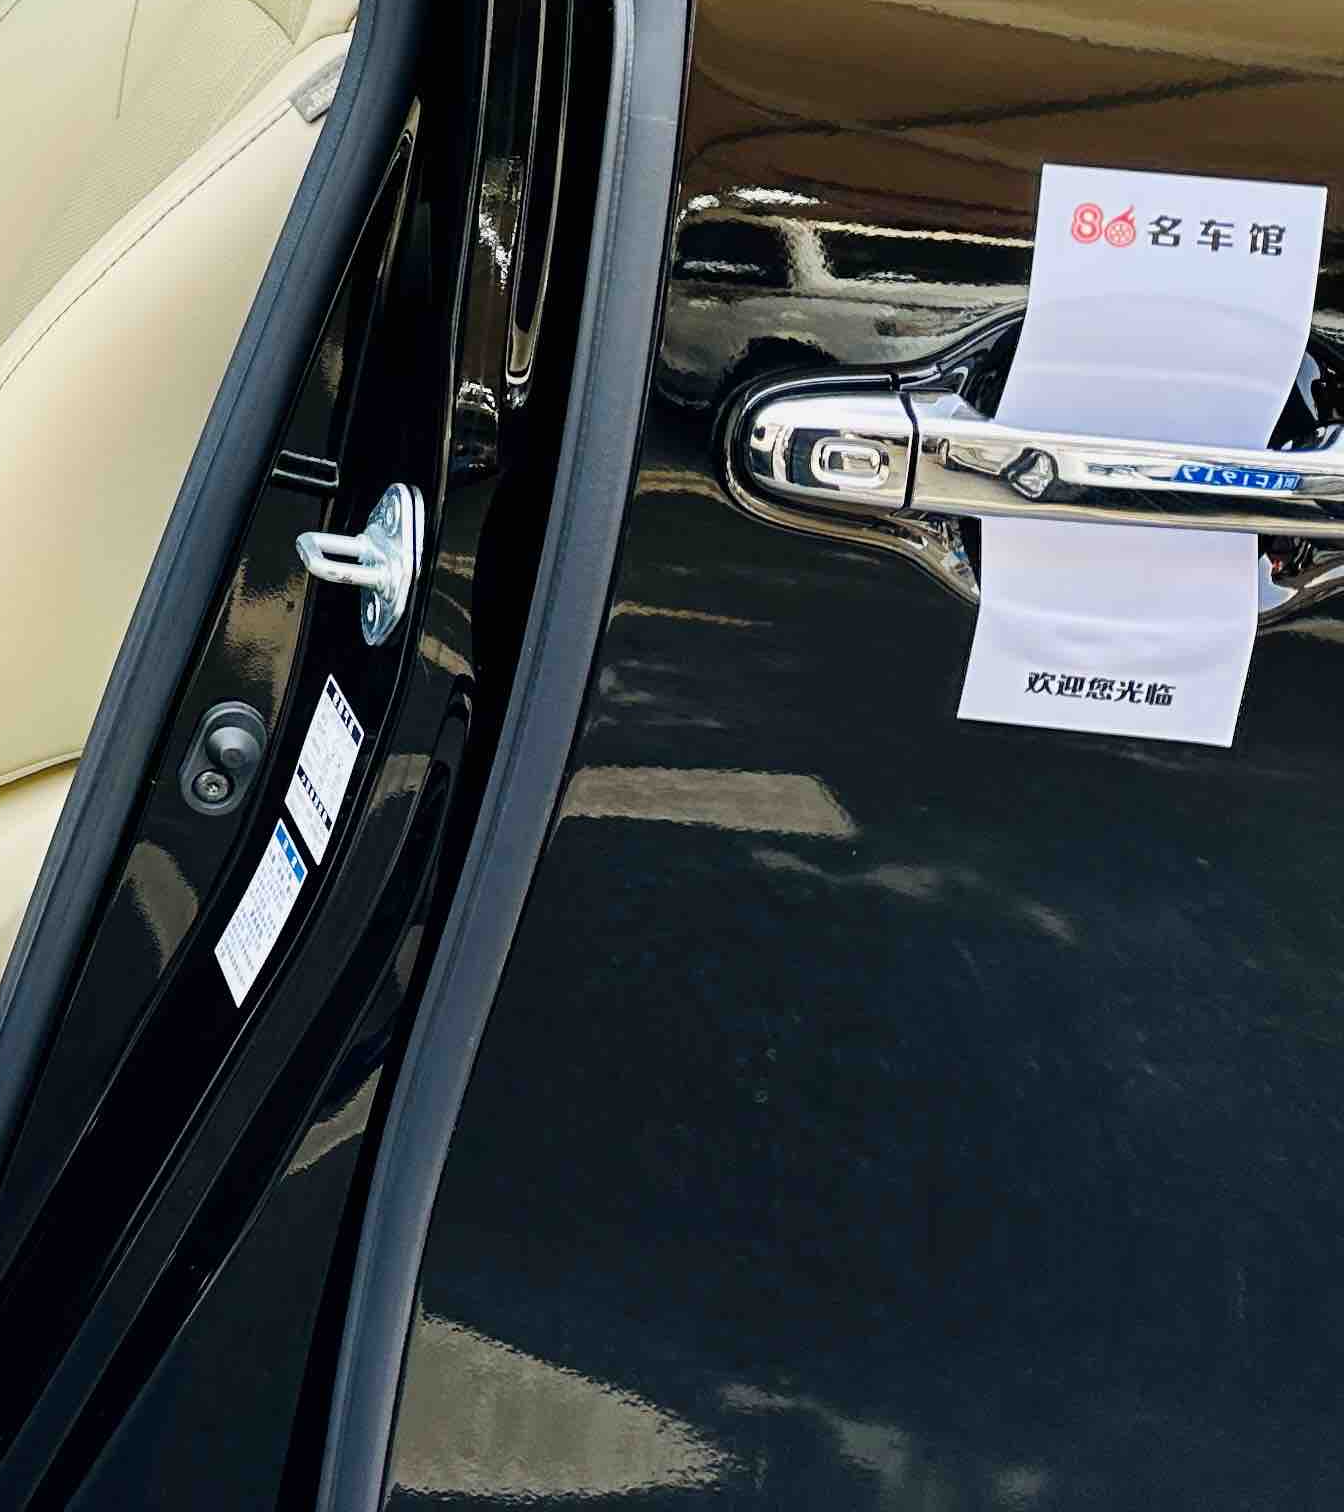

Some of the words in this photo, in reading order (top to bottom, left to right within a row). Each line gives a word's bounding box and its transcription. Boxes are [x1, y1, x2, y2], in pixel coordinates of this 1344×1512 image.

[1024, 671, 1177, 706] 欢迎您光临
